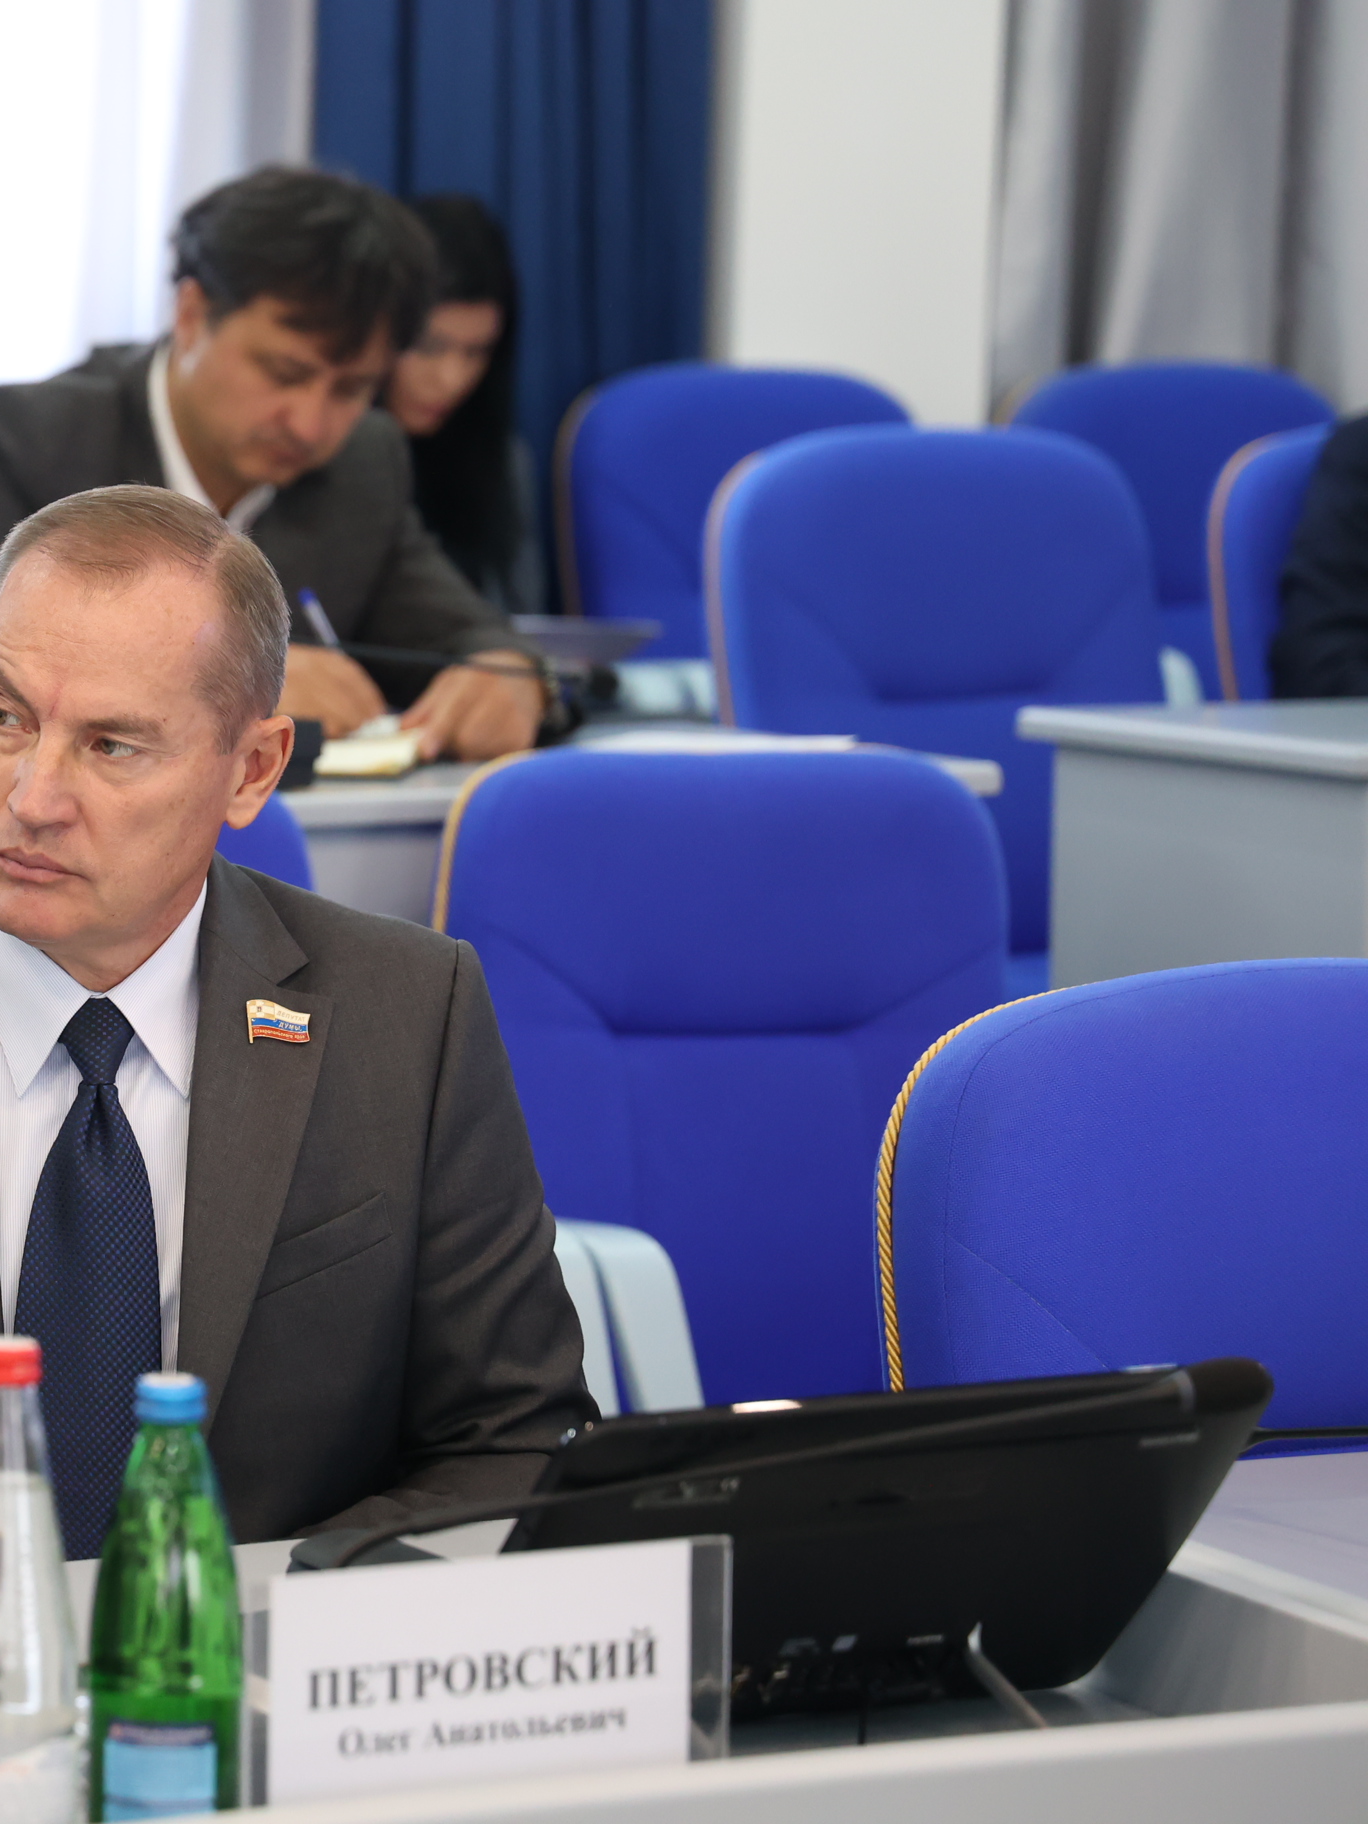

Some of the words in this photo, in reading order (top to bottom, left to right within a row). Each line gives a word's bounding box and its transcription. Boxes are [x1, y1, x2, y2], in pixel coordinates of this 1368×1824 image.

[276, 1010, 306, 1022] ДЕПУТАТ
[308, 1626, 658, 1711] ПЕТРОВСКИЙ
[338, 1726, 412, 1758] Олег
[422, 1708, 627, 1748] Анатольевич
